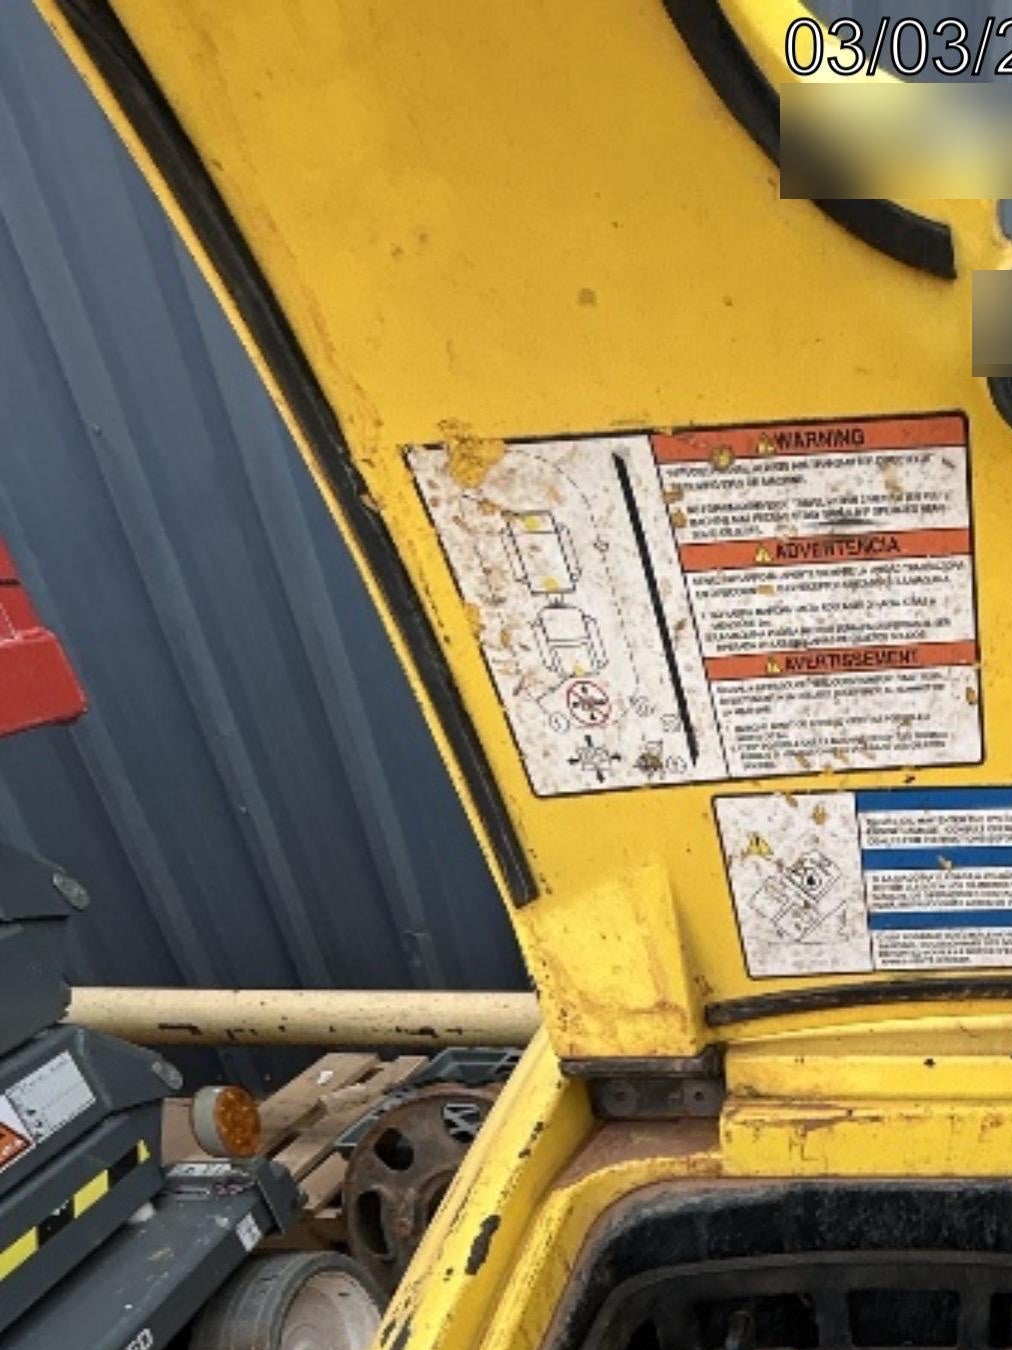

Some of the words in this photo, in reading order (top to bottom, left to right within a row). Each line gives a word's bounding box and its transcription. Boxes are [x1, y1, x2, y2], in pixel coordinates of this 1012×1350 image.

[774, 428, 865, 450] WARNING
[775, 535, 902, 560] ADVERTENCIA
[785, 647, 920, 671] AVERTISSEMENT
